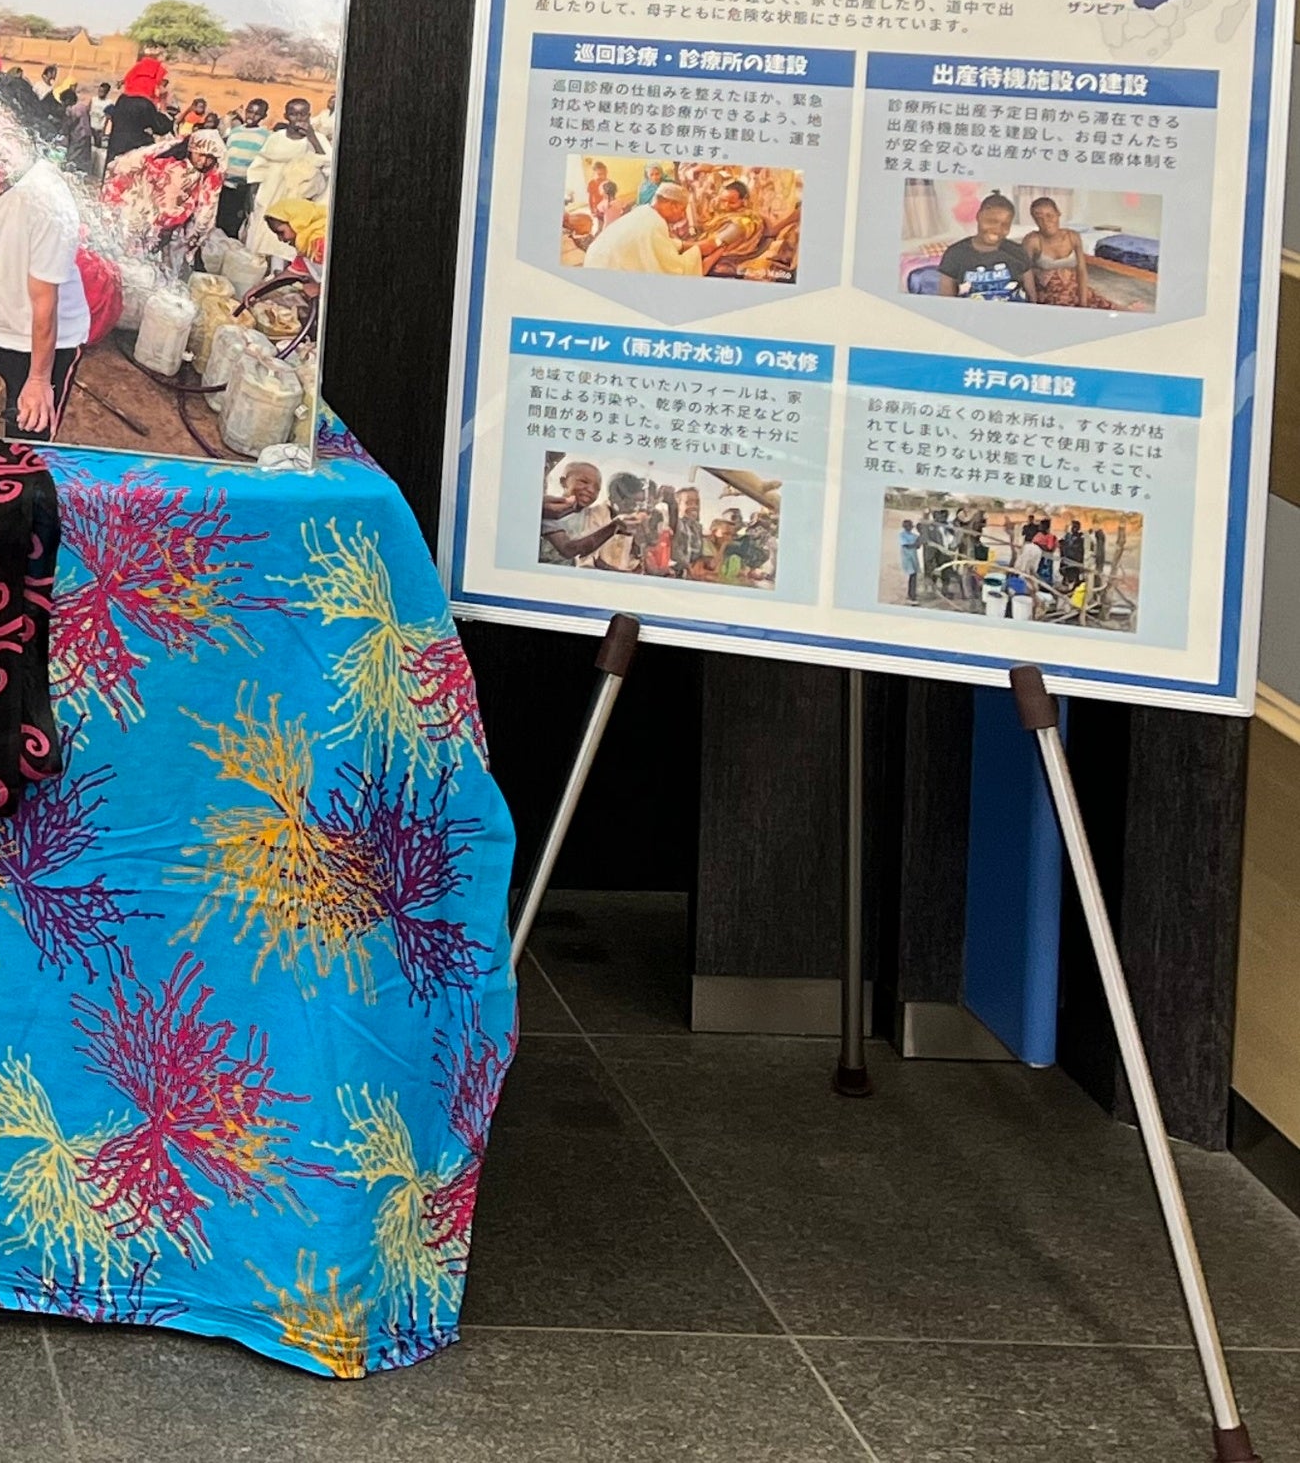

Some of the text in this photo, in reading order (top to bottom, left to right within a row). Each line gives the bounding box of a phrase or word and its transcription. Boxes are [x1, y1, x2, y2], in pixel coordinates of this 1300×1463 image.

[1068, 2, 1125, 15] ザンビア
[574, 43, 808, 76] 巡回診療・診療所の建設
[552, 78, 823, 108] 巡回診療の仕組みを整えたほか、緊急
[932, 64, 1148, 96] 出産待機施設の建設
[551, 97, 822, 127] 対応や継続的な診療ができるよう、地
[888, 98, 1180, 129] 診療所に出産予定日前から滞在できる
[549, 116, 821, 147] 域に拠点となる診療所も建設し、運営
[549, 135, 729, 160] のサポートをしています。
[887, 118, 1179, 149] 出産待機施設を建設し、お母さんたち
[884, 157, 975, 176] 整えました。
[885, 138, 1177, 170] が安全安心な出産ができる医療体制を
[521, 330, 818, 373] ハフィール（雨水貯水池）の改修
[531, 366, 802, 405] 地域で使われていたハフィールは、家
[964, 367, 1077, 398] 井戸の建設
[529, 385, 800, 424] 畜による汚染や、乾季の水不足などの
[867, 397, 1165, 440] 診療所の近くの給水所は、すぐ水が枯
[528, 404, 800, 444] 問題がありました。安全な水を十分に
[866, 418, 1164, 460] れてしまい、分娩などで使用するには
[526, 423, 774, 461] 供給できるよう改修を行いました。
[866, 438, 1153, 480] とても足りない状態でした。そこで、
[864, 457, 1152, 501] 現在、新たな井戸を建設しています。
